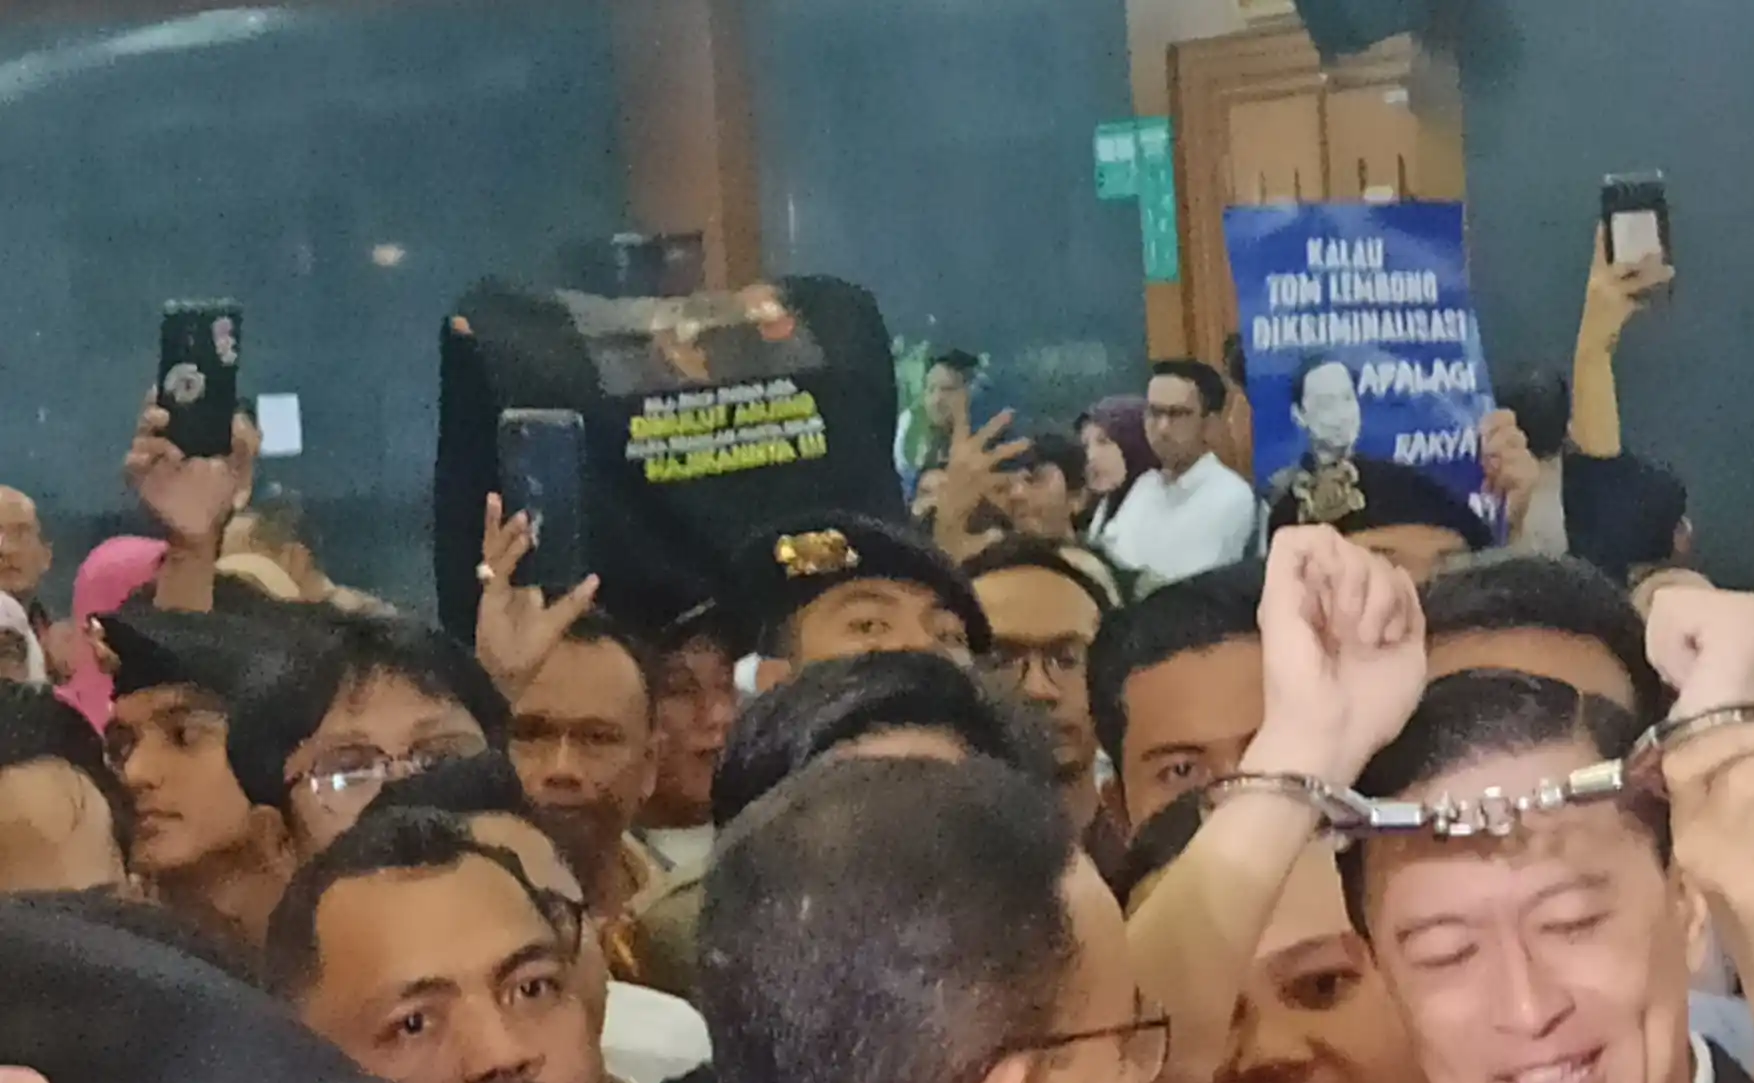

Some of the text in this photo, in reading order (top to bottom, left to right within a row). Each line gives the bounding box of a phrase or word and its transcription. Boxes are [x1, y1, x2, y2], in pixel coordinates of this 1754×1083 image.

[1306, 237, 1384, 269] KALAU
[1267, 271, 1322, 306] TOM
[1358, 358, 1476, 397] APALAGI
[1393, 426, 1478, 465] RAKYA
